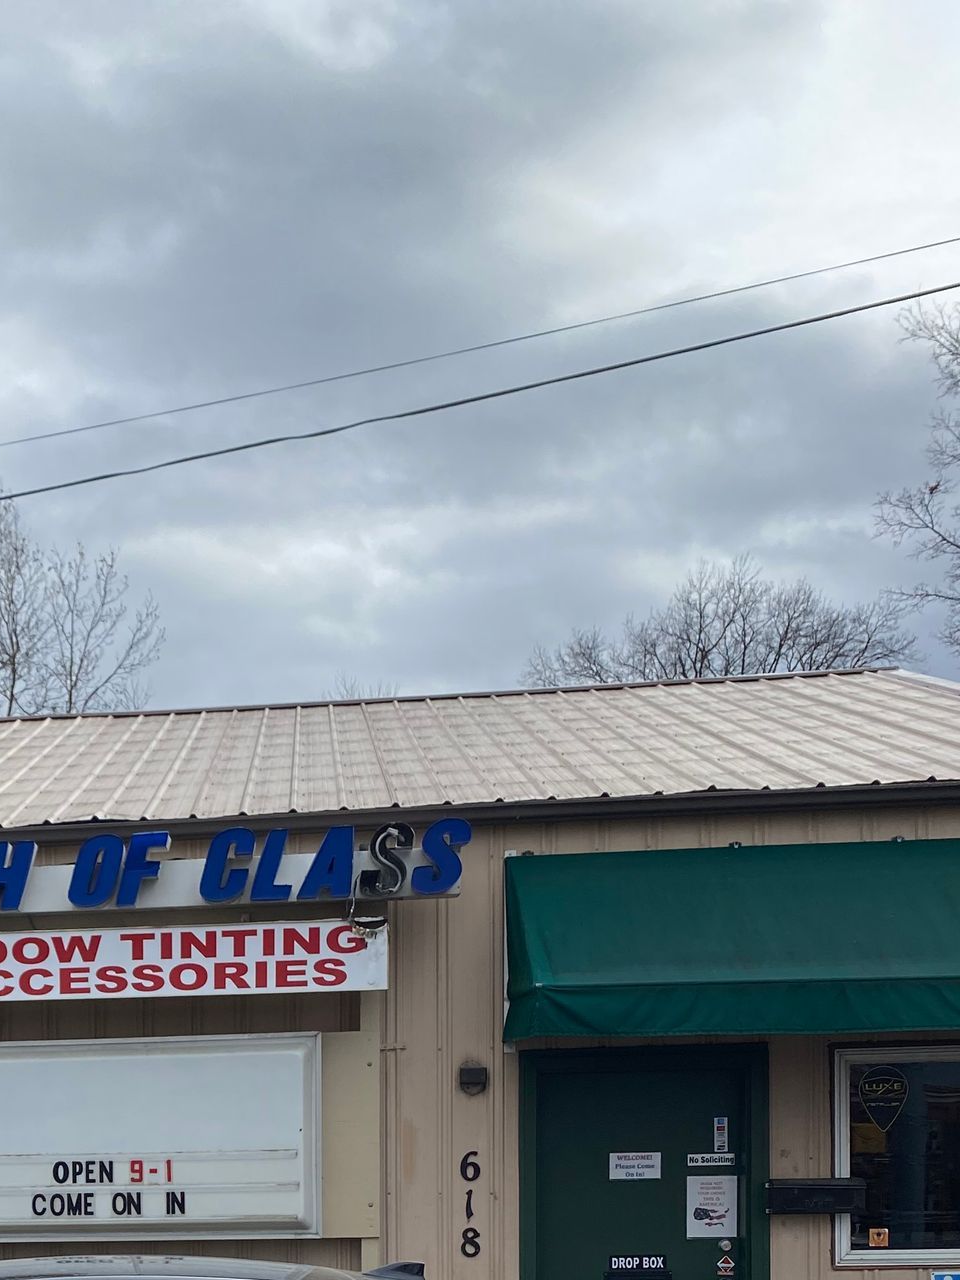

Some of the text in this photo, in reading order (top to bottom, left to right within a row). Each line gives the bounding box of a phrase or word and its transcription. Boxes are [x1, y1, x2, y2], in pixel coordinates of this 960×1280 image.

[68, 831, 171, 907] OF
[200, 818, 472, 903] CLASS
[120, 925, 368, 961] TINTING
[865, 1082, 902, 1091] LUXE
[52, 1159, 172, 1184] OPEN 9-1
[689, 1155, 735, 1165] No Soliciting
[31, 1191, 185, 1216] COME ON IN
[460, 1151, 480, 1258] 618
[611, 1256, 664, 1269] DROP BOX
